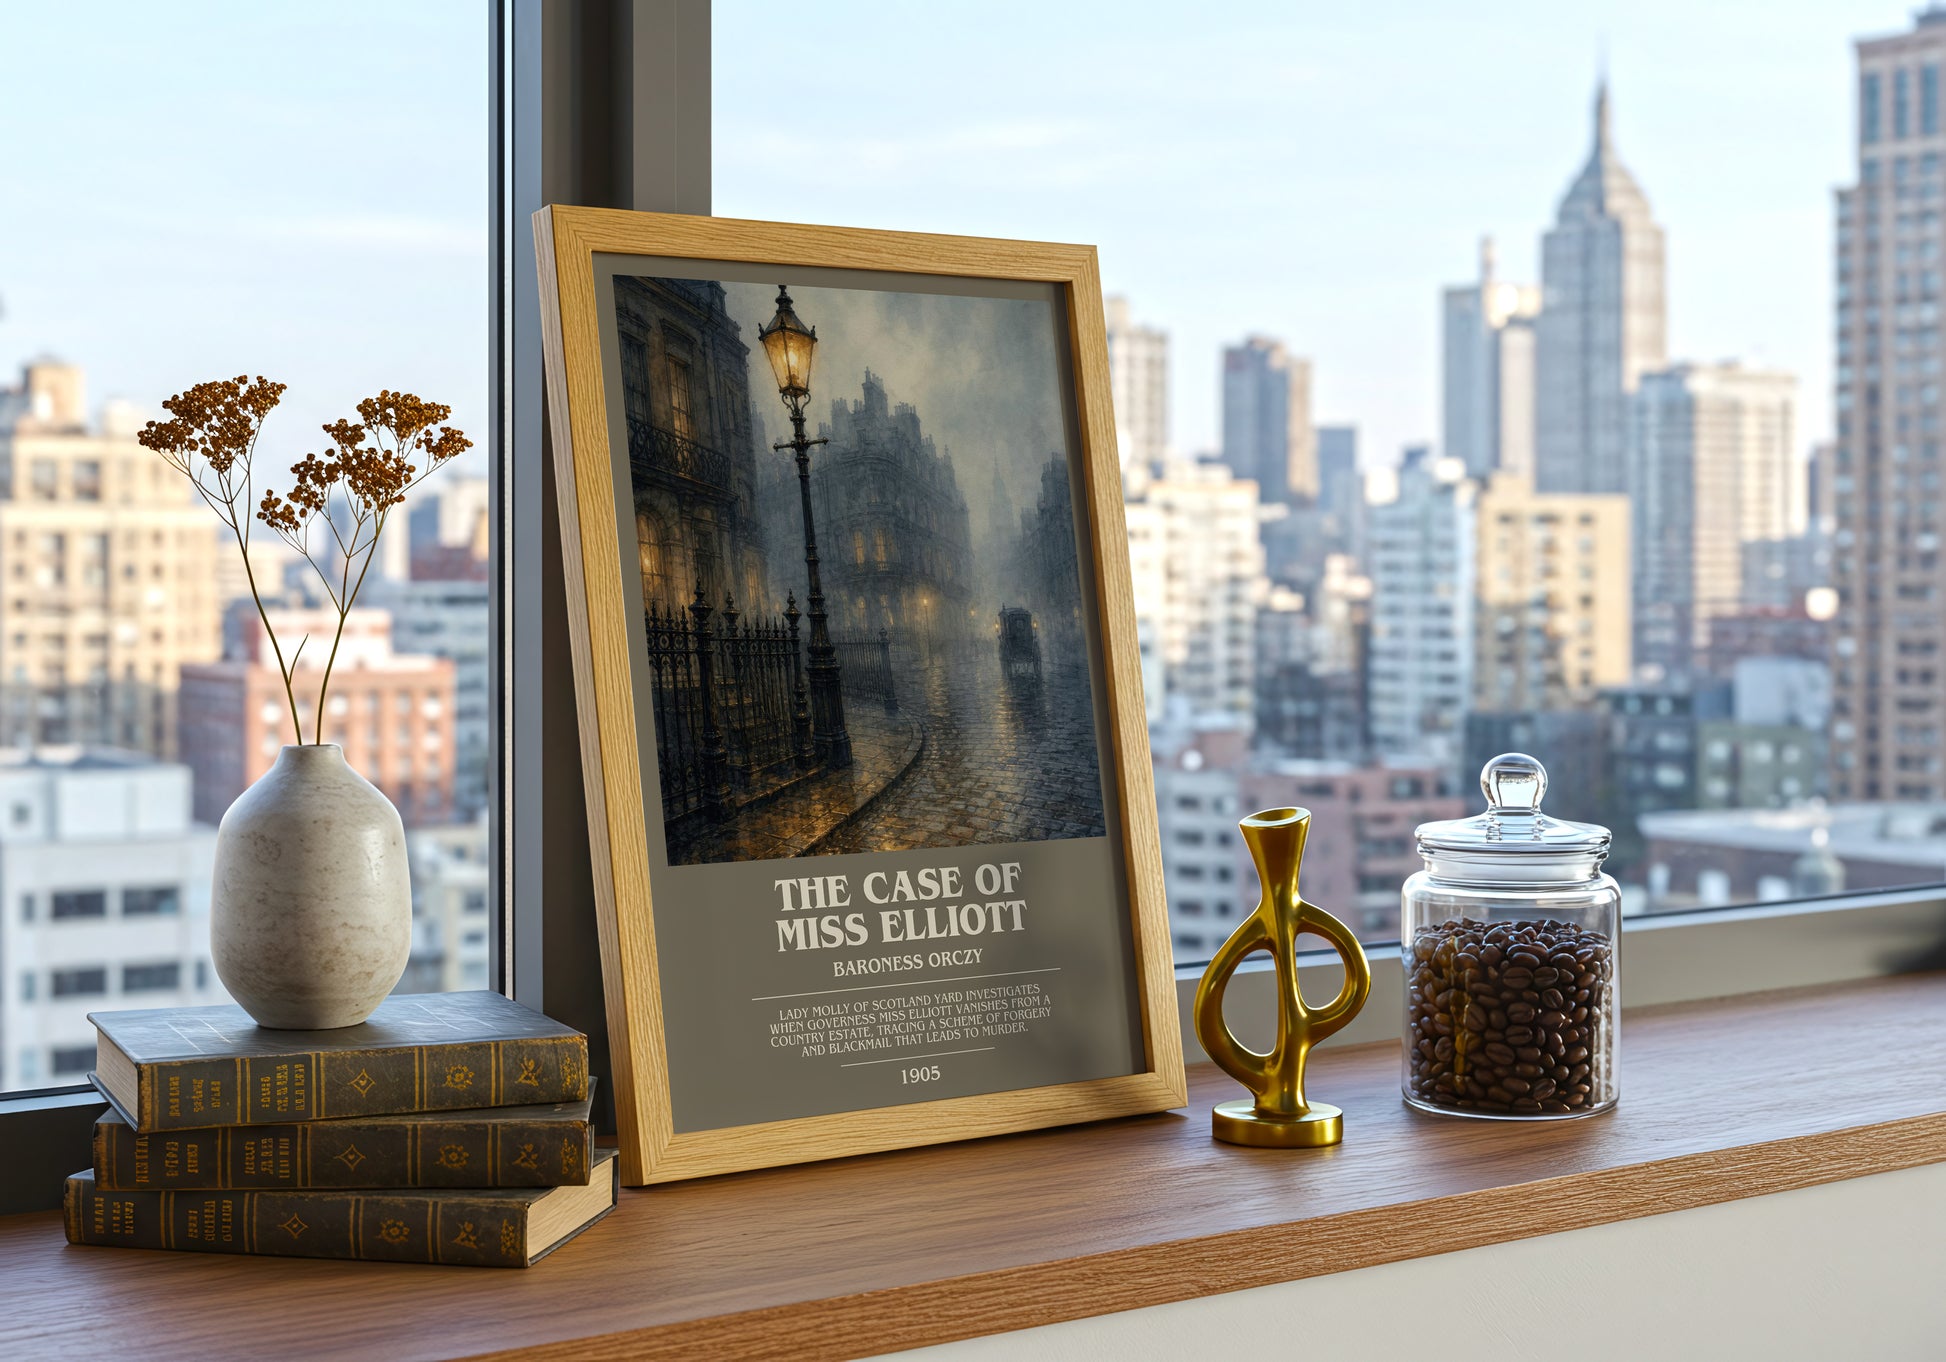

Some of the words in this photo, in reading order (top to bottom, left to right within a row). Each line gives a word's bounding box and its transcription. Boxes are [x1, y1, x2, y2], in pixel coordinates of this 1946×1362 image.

[775, 875, 851, 911] THE
[864, 867, 963, 904] CASE
[975, 863, 1021, 895] OF
[776, 913, 868, 952] MISS
[879, 900, 1027, 942] ELLIOTT
[834, 954, 923, 976] BARONESS
[929, 949, 982, 967] ORCZY
[770, 1021, 803, 1034] WHEN
[808, 1014, 876, 1030] GOVERNESS
[880, 1011, 905, 1022] MISS
[909, 1005, 952, 1019] ELLIOTT
[956, 1000, 1008, 1014] VANISHES
[1012, 996, 1040, 1008] FROM
[1044, 995, 1050, 1005] A
[780, 1008, 808, 1020] LADY
[813, 1003, 849, 1017] MOLLY
[854, 1001, 868, 1012] OF
[872, 995, 931, 1010] SCOTLAND
[934, 992, 962, 1004] YARD
[966, 984, 1040, 1001] INVESTIGATES
[771, 1032, 824, 1047] COUNTRY
[829, 1027, 873, 1041] ESTATE,
[877, 1021, 925, 1035] TRACING
[929, 1020, 936, 1030] A
[939, 1015, 983, 1029] SCHEME
[986, 1013, 1000, 1023] OF
[1004, 1007, 1051, 1021] FORGERY
[802, 1045, 825, 1057] AND
[830, 1038, 892, 1054] BLACKMAIL
[895, 1034, 923, 1046] THAT
[927, 1029, 961, 1042] LEADS
[964, 1027, 978, 1038] TO
[982, 1022, 1028, 1036] MURDER.
[902, 1066, 940, 1084] 1905
